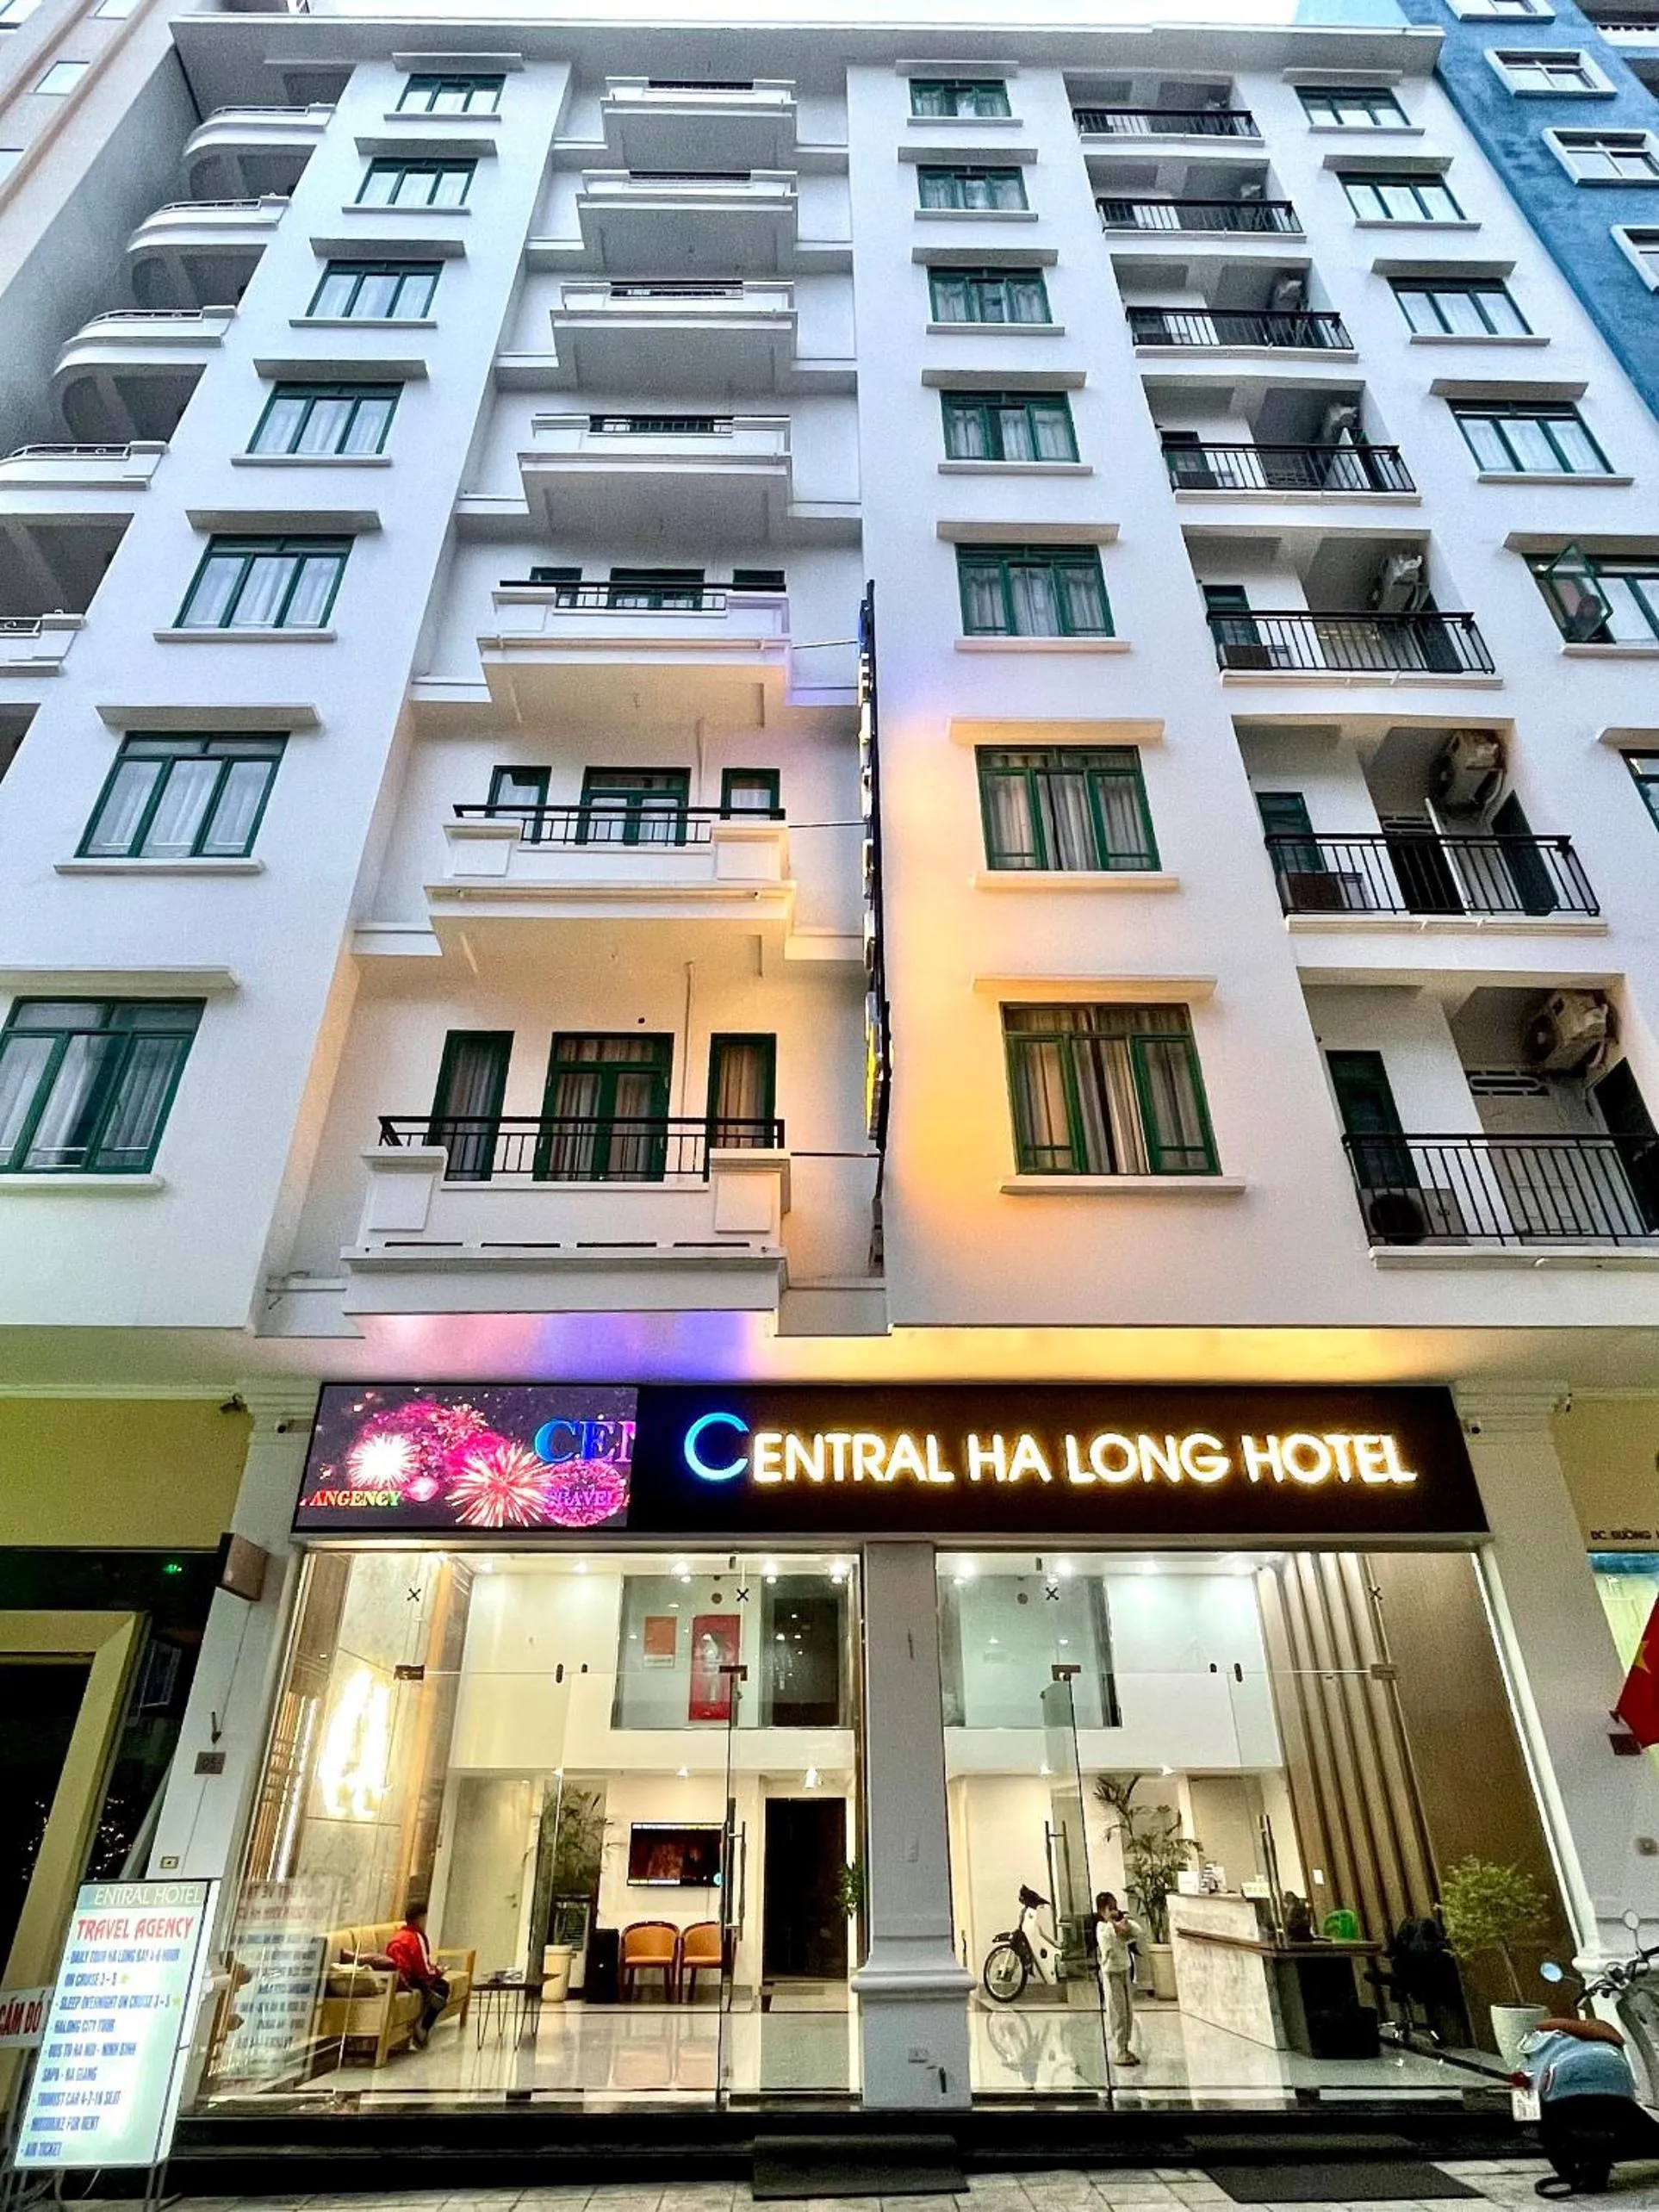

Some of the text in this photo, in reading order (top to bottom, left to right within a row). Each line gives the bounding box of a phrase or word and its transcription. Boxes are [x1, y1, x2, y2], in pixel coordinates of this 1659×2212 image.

[683, 1412, 1419, 1484] CENTRAL HA LONG HOTEL
[153, 1885, 202, 1904] HOTEL
[77, 1916, 195, 1941] TRAVEL AGENCY
